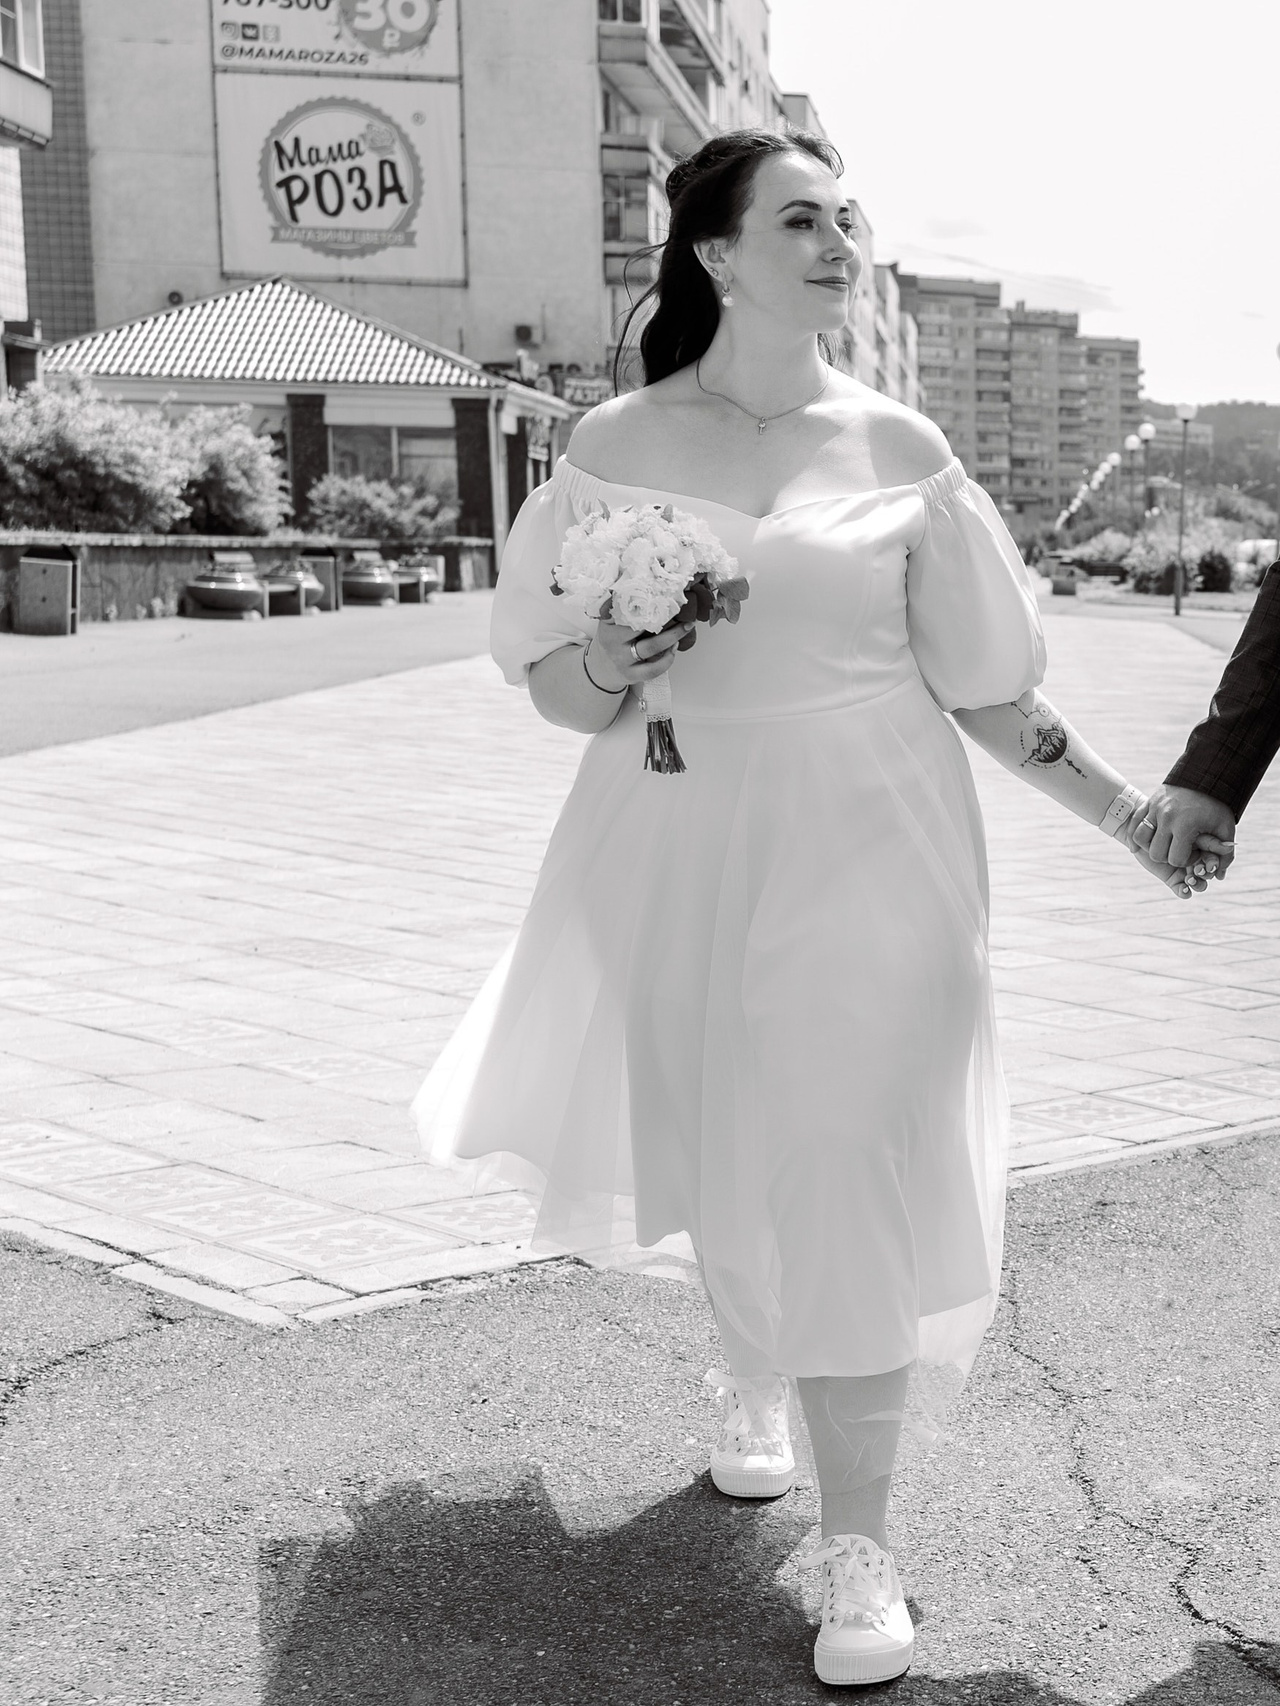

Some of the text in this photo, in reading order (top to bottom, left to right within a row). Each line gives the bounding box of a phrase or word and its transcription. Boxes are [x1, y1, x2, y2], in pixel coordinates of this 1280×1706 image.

[353, 0, 431, 33] 30
[273, 136, 366, 172] Мама
[275, 158, 409, 223] РОЗА
[278, 227, 353, 244] МАГАЗИНЫ
